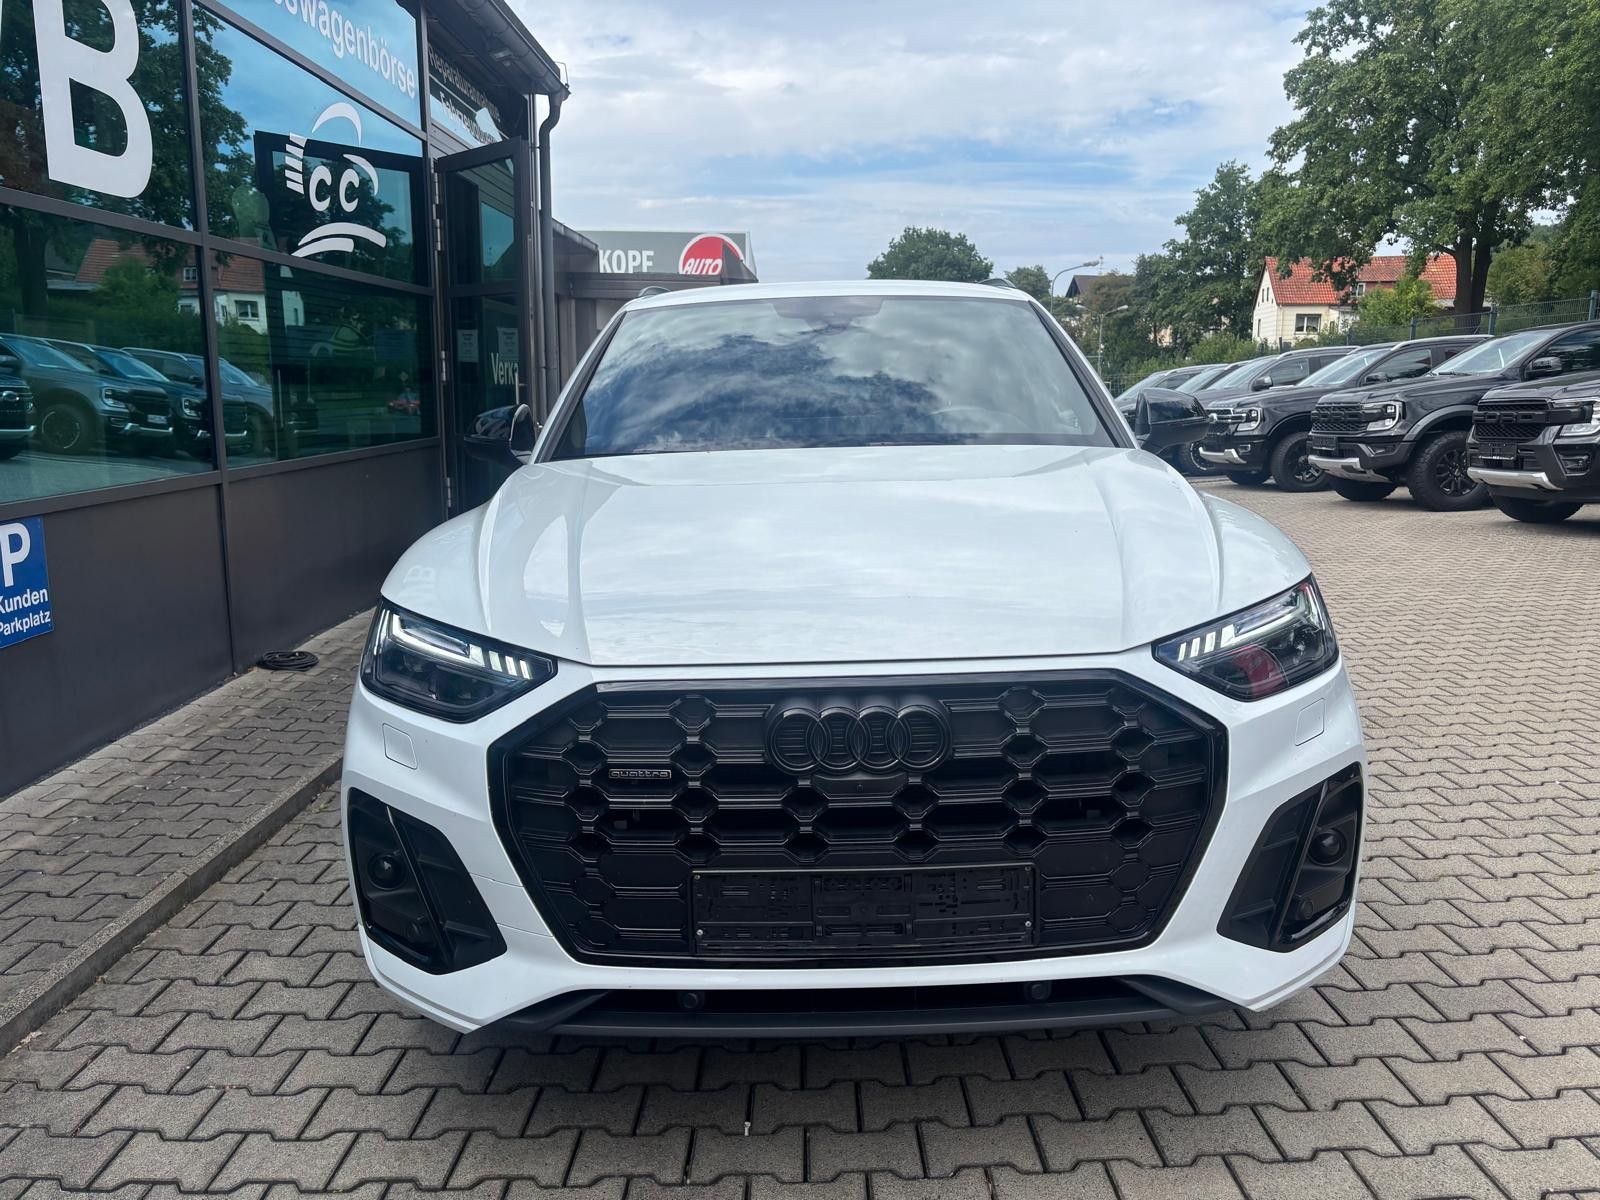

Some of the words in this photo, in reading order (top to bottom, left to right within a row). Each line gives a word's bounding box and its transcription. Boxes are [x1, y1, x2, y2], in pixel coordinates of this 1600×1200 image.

[274, 0, 416, 99] wagenbörse
[33, 0, 153, 198] B
[600, 249, 655, 273] KOPF
[684, 258, 723, 275] AUTO
[0, 522, 31, 587] P
[610, 770, 669, 778] quattro
